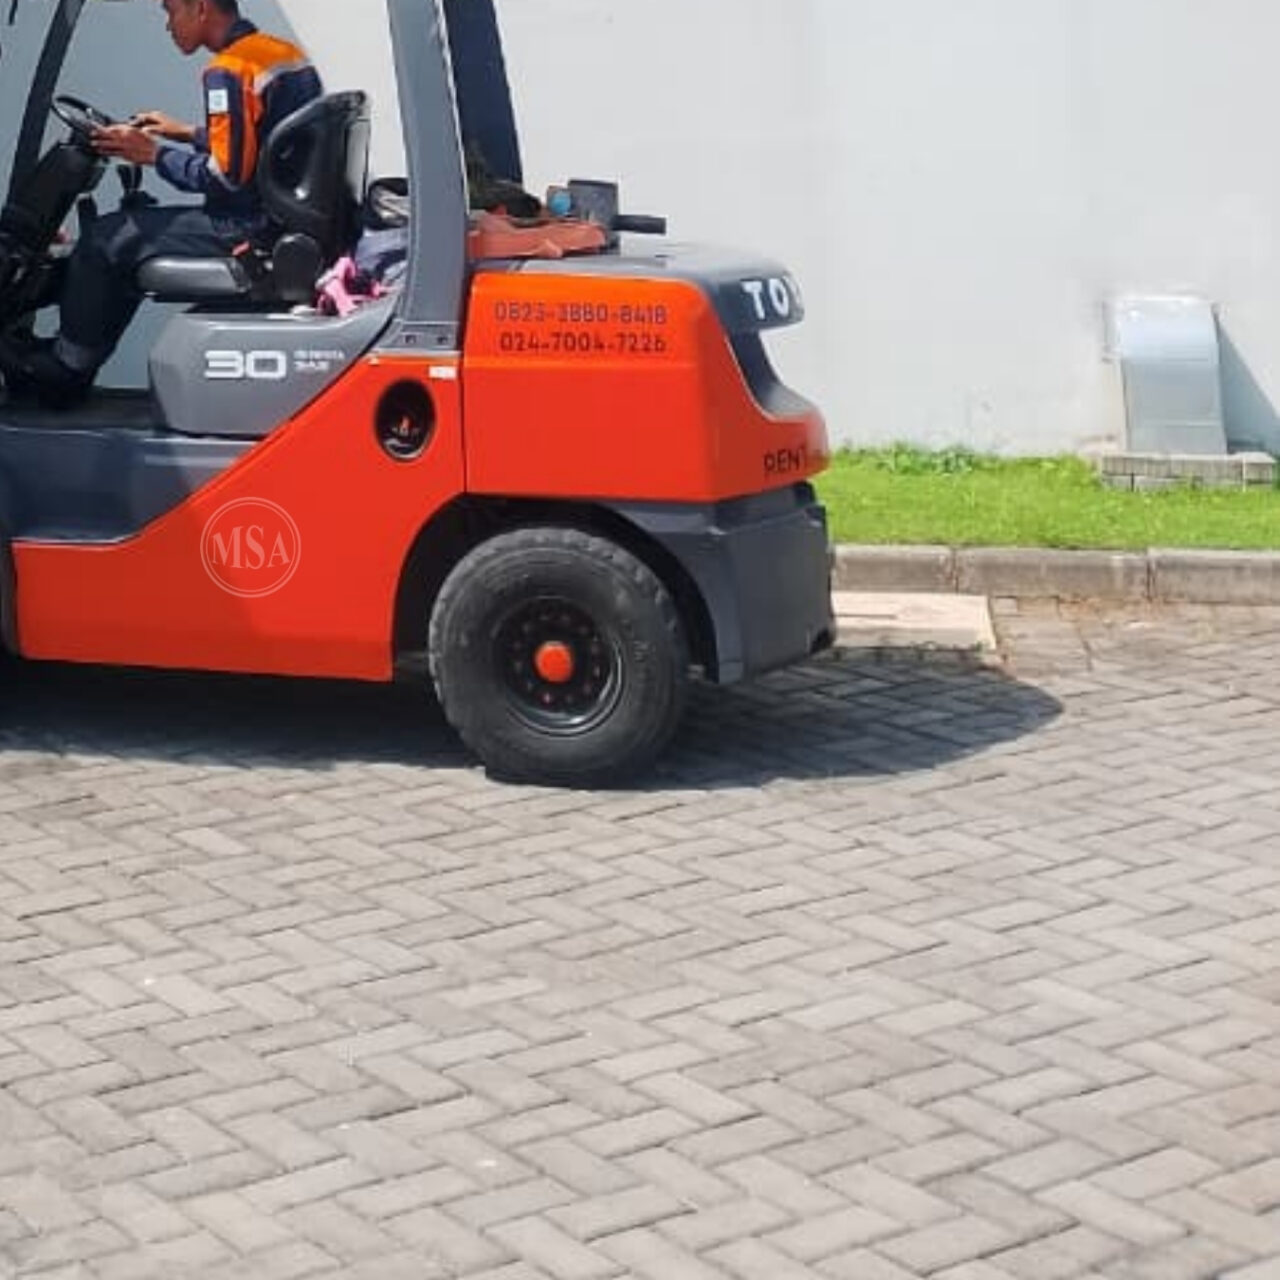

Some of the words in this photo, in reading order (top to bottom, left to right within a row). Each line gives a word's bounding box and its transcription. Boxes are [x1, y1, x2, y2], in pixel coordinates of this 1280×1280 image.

[740, 278, 791, 320] TO
[499, 330, 667, 352] 024-7004-7226
[204, 350, 287, 379] 30
